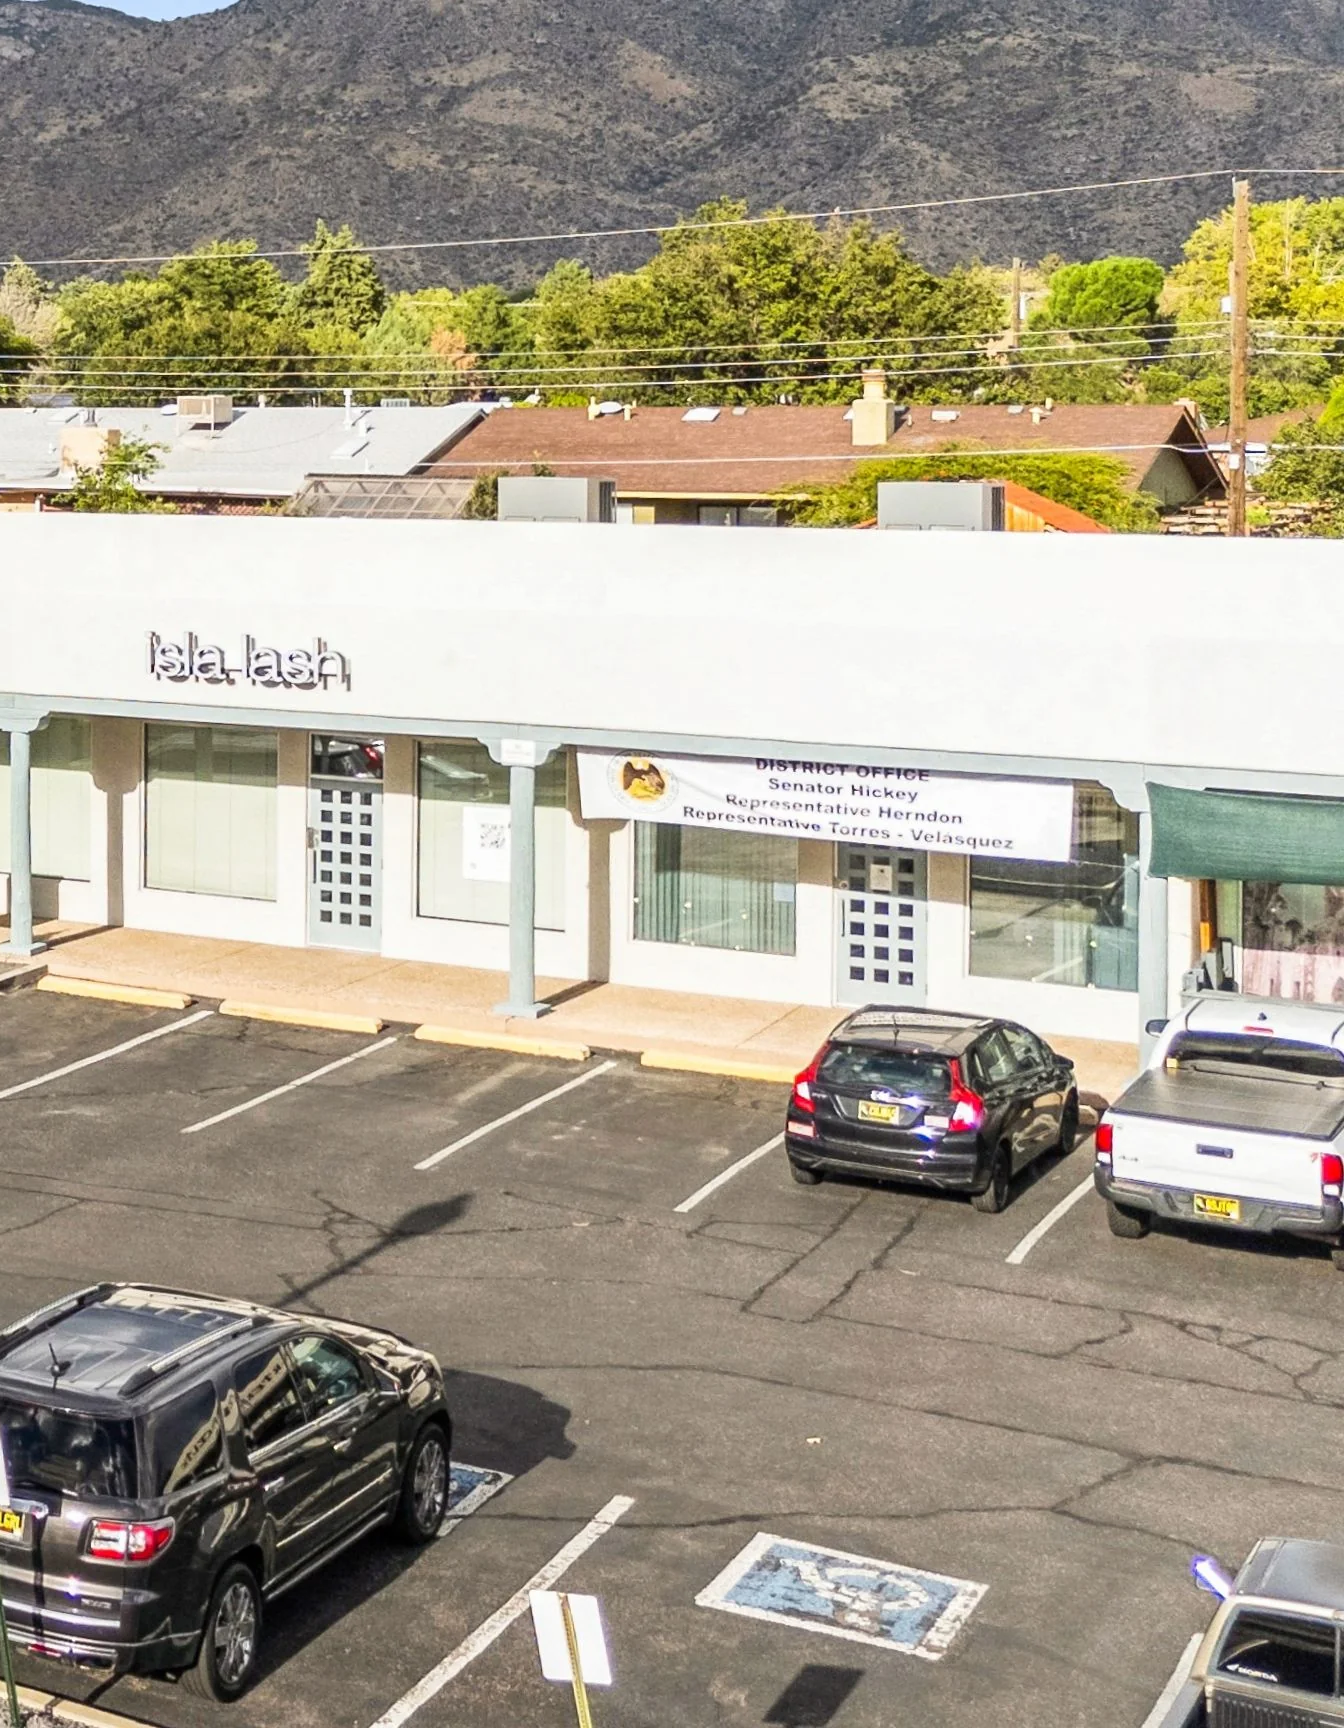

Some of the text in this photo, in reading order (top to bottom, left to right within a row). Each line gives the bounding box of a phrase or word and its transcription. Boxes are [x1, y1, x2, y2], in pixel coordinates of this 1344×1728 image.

[145, 631, 346, 684] isla lash
[755, 757, 930, 782] DISTRICT OFFICE
[768, 777, 919, 803] Senator Hickey
[683, 806, 821, 832] Representative
[828, 821, 890, 839] Torres
[726, 793, 963, 825] Representative Herndon
